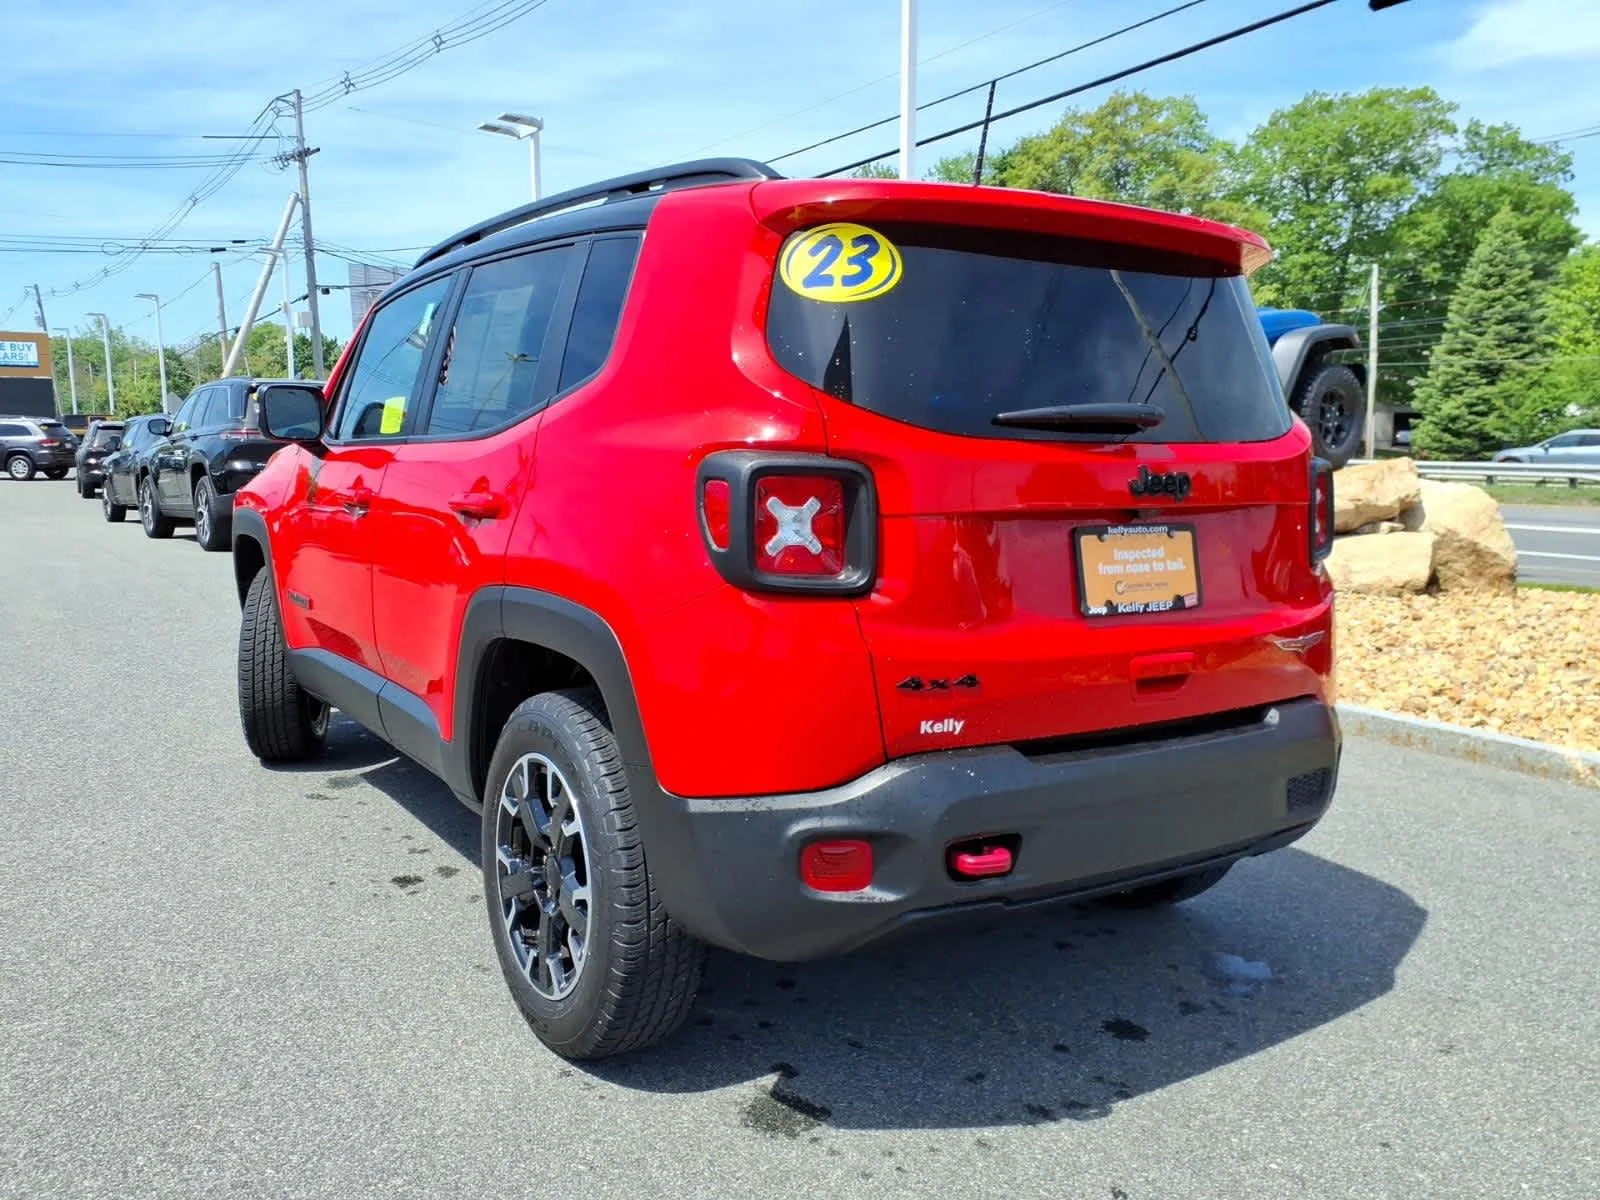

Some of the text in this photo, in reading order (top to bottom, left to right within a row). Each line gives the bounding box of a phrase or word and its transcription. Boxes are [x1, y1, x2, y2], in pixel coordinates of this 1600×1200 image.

[803, 234, 880, 288] 23
[10, 343, 33, 352] BUY
[1127, 464, 1191, 501] Jeep
[1107, 525, 1168, 536] kellyauto.com
[1113, 546, 1165, 560] Inspected
[1097, 562, 1123, 576] from
[1153, 560, 1164, 572] to
[1117, 600, 1174, 613] Kelly JEEP
[920, 718, 965, 735] Kelly
